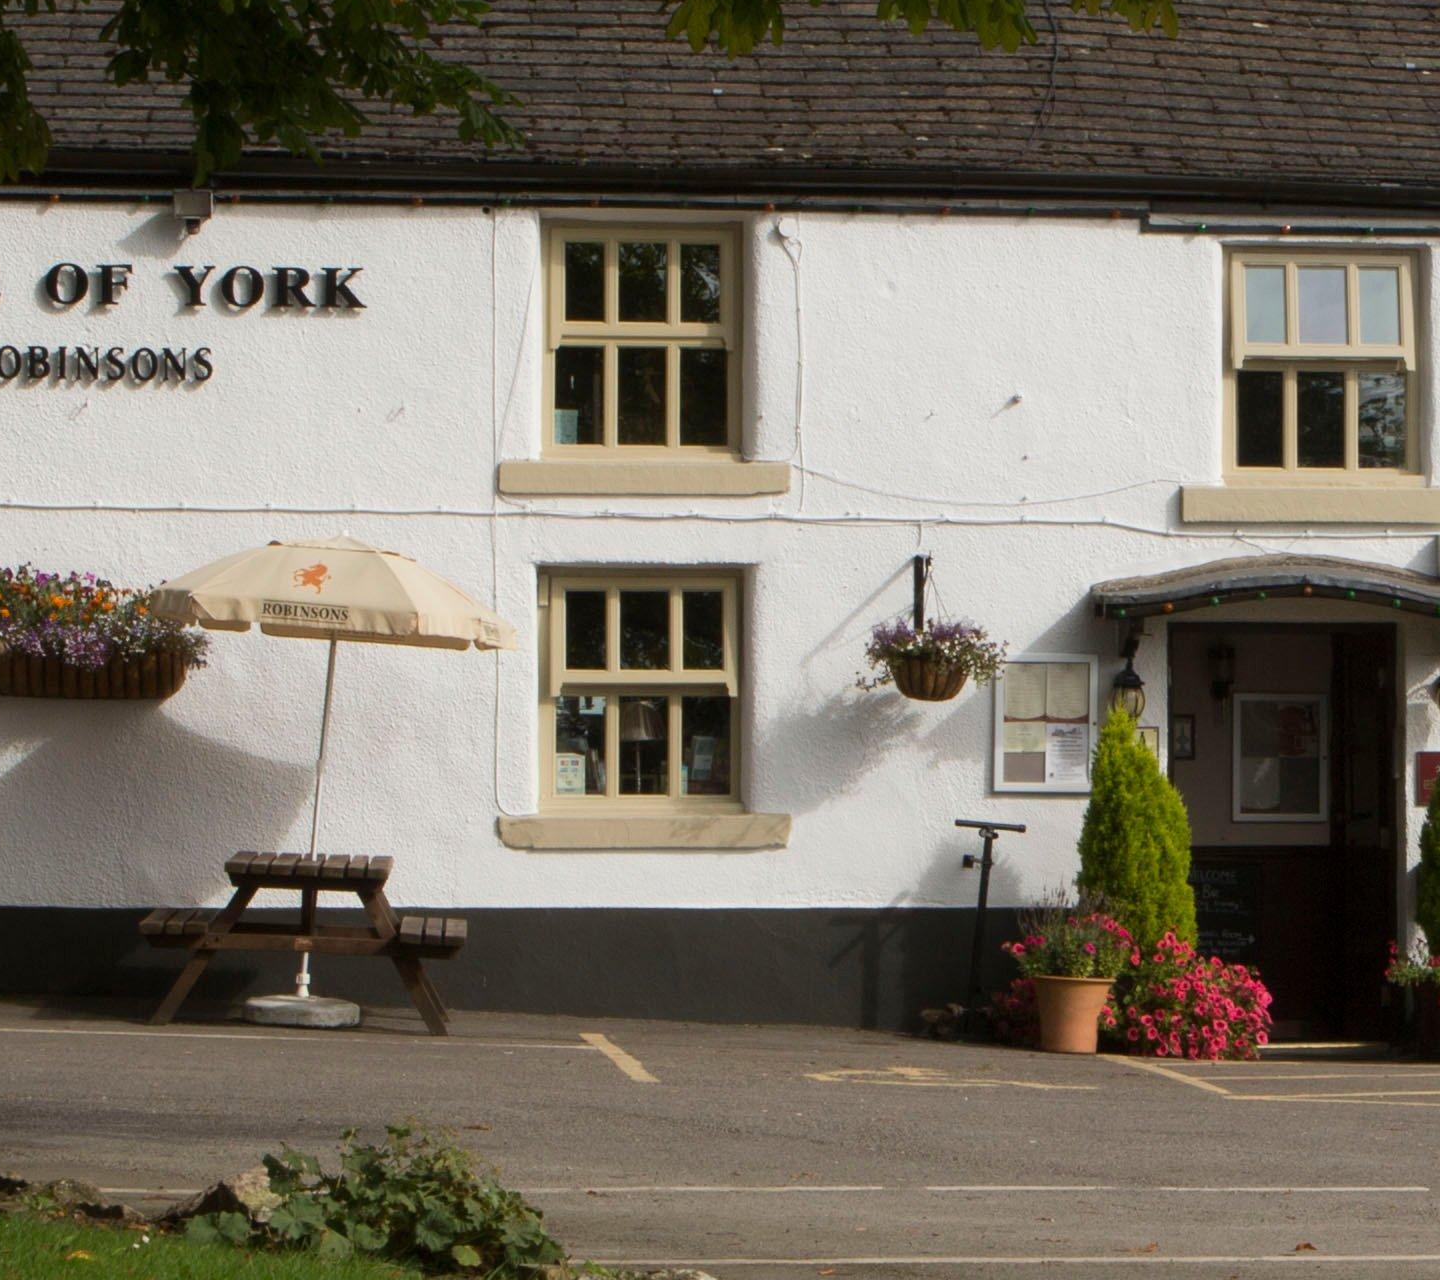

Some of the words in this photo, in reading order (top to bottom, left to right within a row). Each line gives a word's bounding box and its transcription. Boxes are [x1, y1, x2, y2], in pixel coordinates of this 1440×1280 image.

[44, 262, 133, 306] OF
[173, 265, 366, 309] YORK
[257, 602, 349, 621] ROBINSONS
